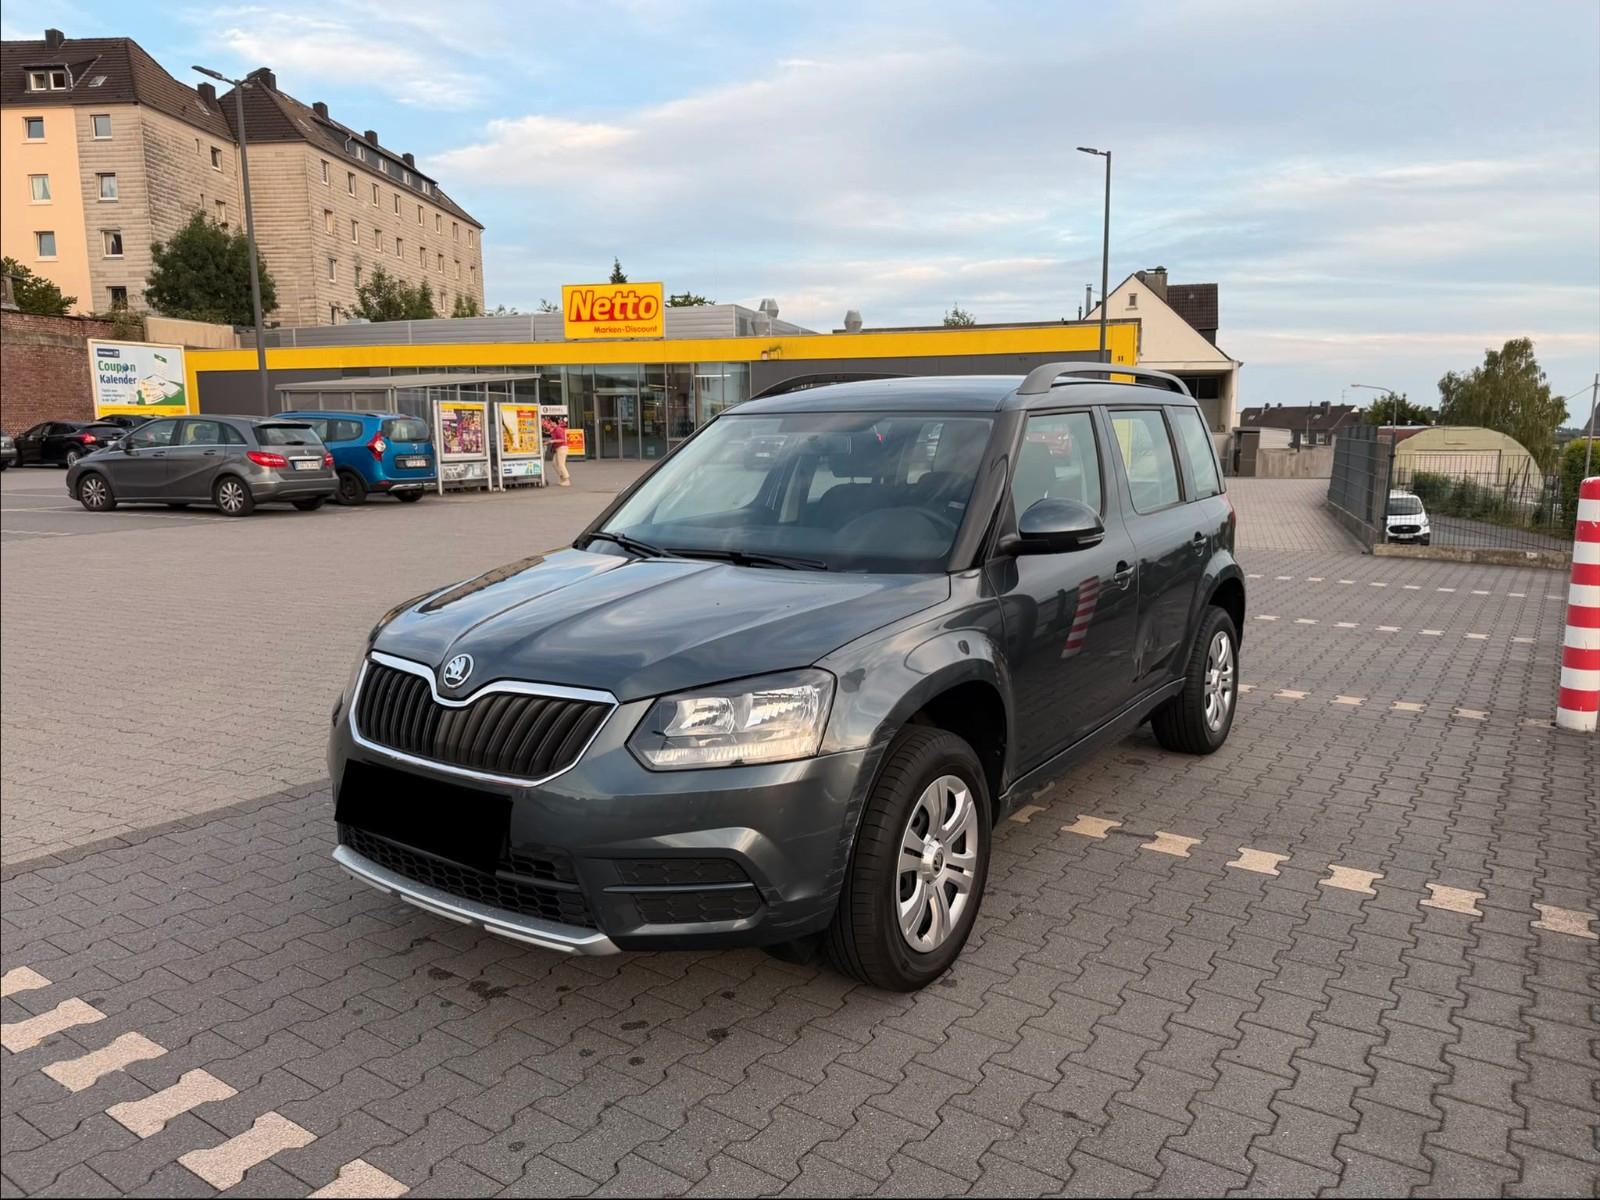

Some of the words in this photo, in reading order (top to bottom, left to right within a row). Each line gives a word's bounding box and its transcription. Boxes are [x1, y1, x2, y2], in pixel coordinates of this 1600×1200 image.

[569, 290, 658, 322] Netto
[98, 360, 136, 374] Coupon
[100, 374, 137, 384] Kalender
